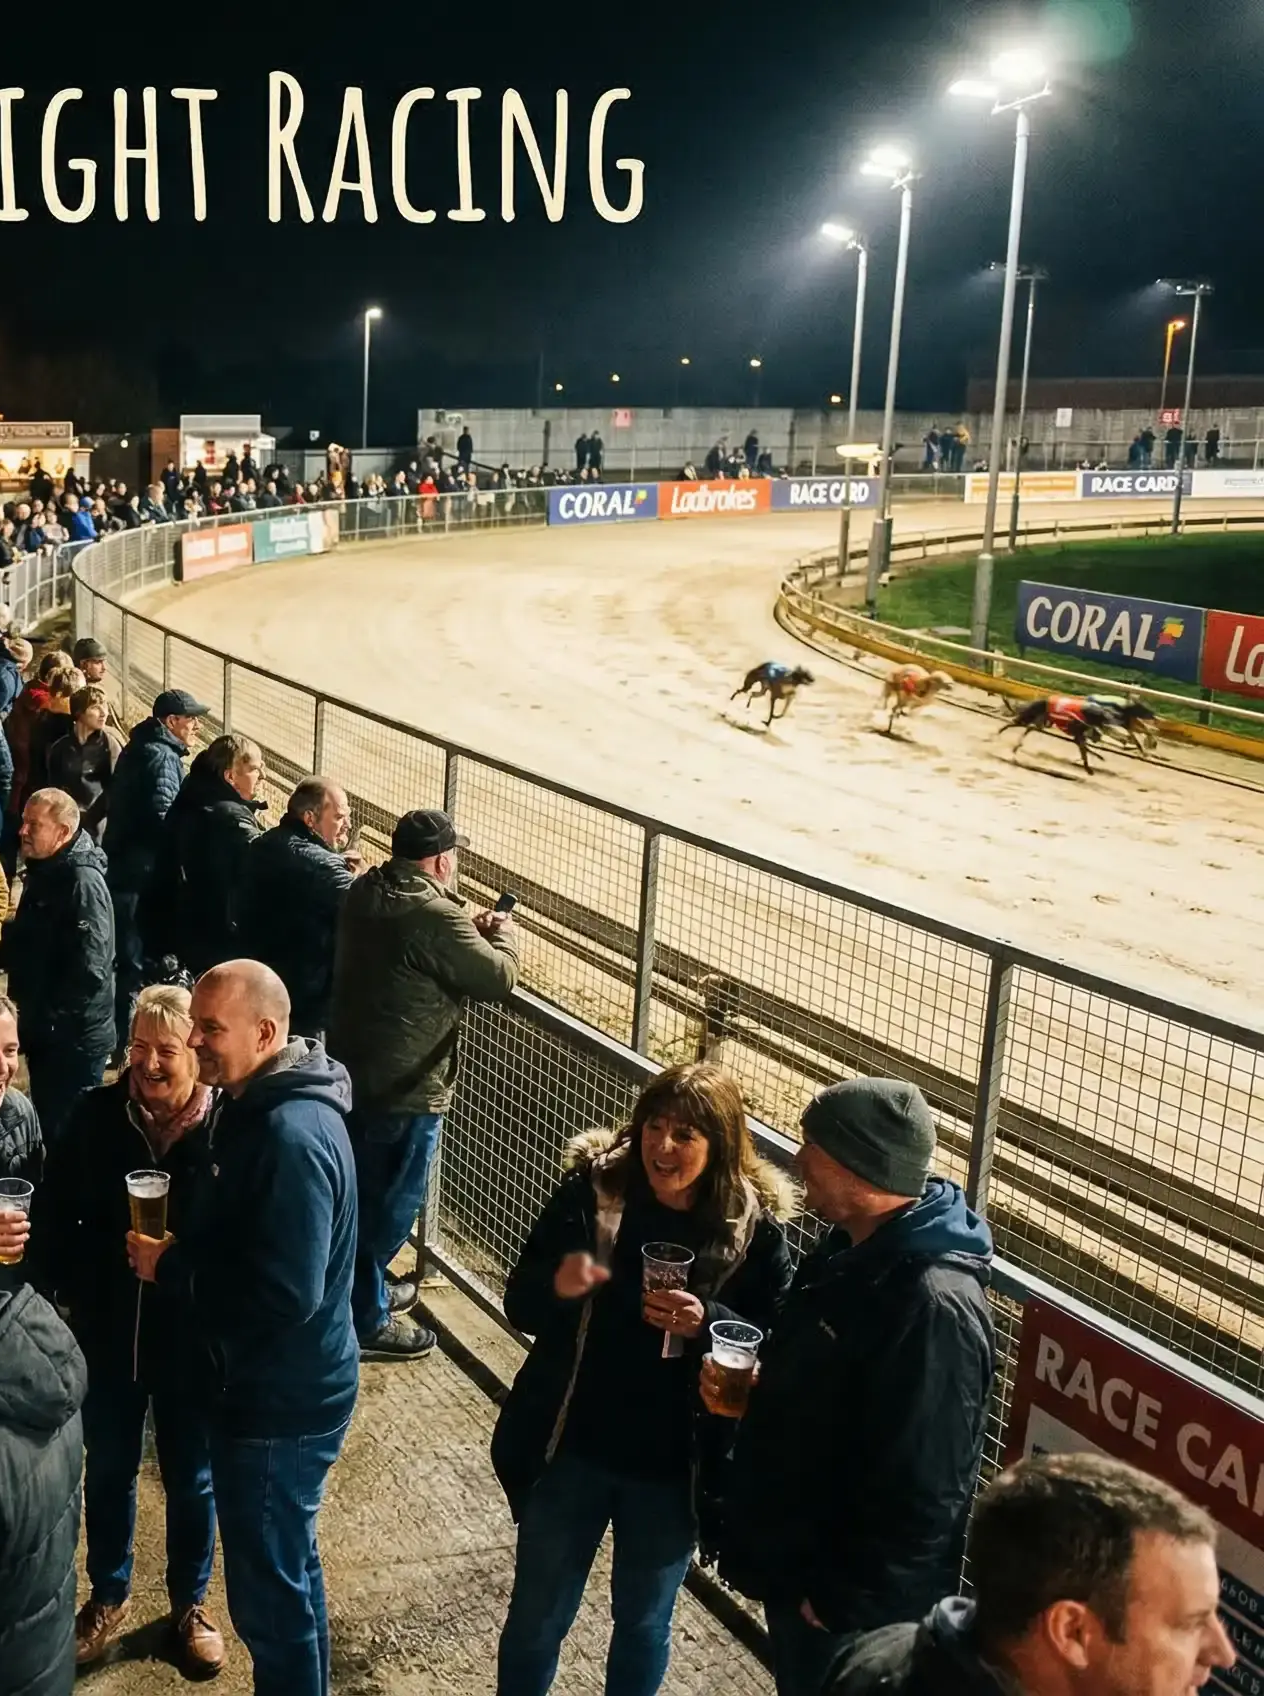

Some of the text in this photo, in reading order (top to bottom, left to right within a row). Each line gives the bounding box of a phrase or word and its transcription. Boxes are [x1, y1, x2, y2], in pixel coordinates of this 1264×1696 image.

[790, 482, 828, 504] RACE
[1091, 477, 1132, 493] RACE
[1135, 475, 1179, 493] CARD
[558, 490, 635, 520] CORAL
[670, 486, 758, 514] Ladbrokes
[1026, 596, 1157, 662] CORAL
[1036, 1332, 1163, 1451] RACE
